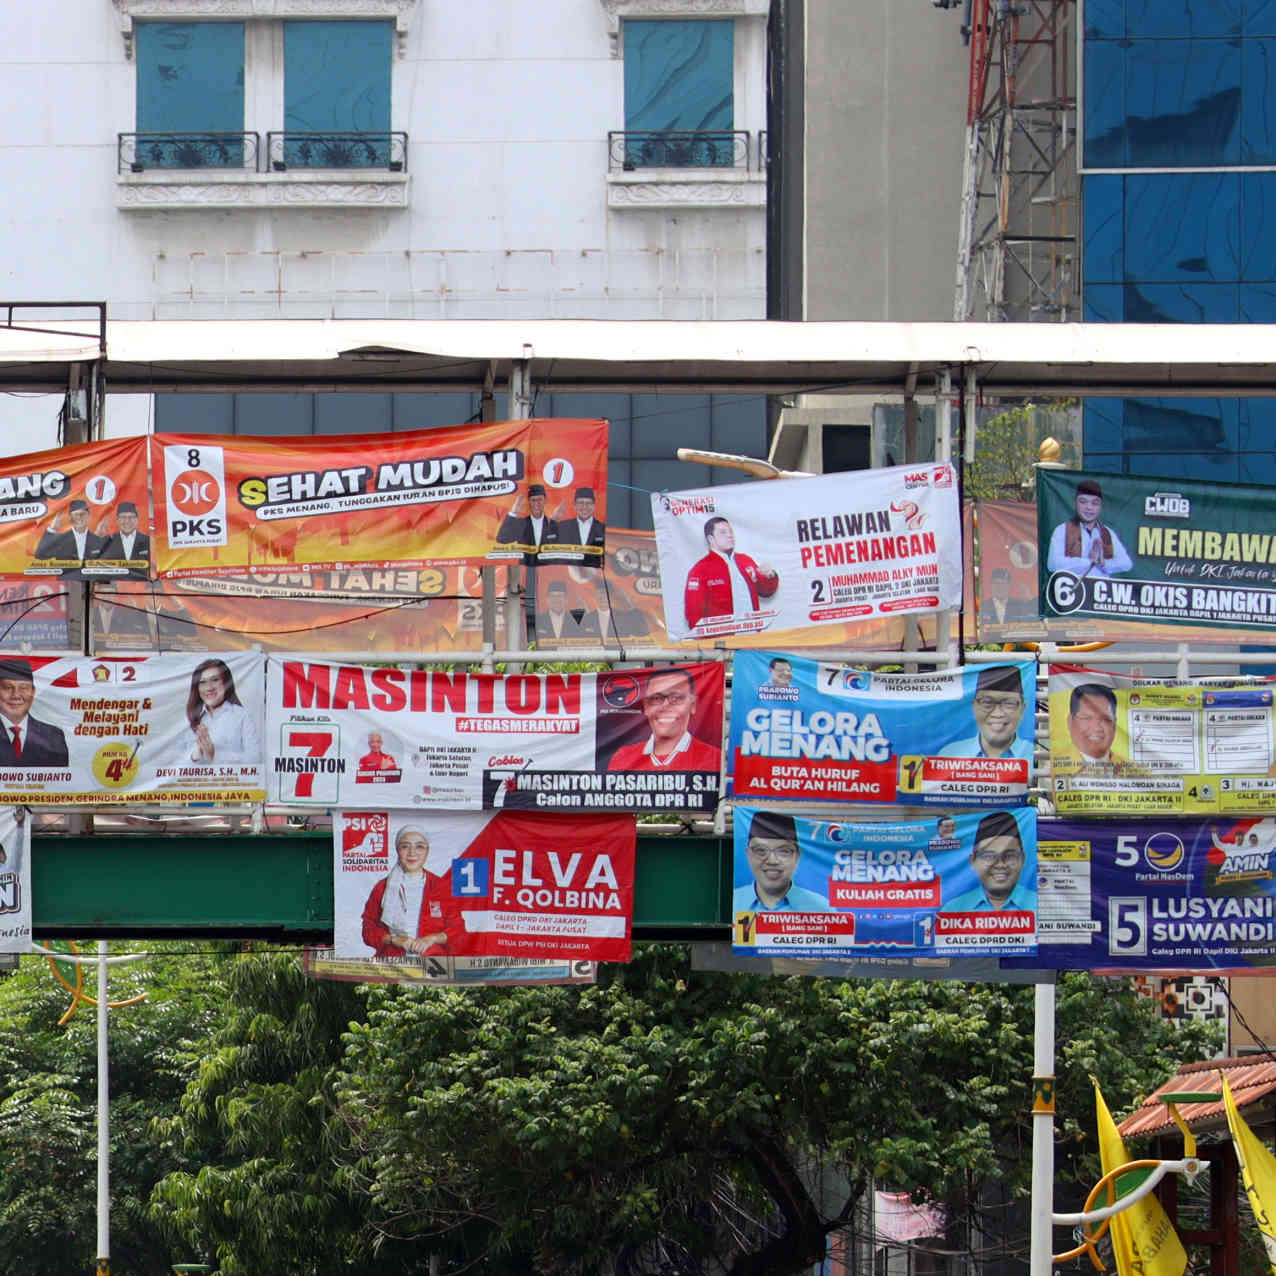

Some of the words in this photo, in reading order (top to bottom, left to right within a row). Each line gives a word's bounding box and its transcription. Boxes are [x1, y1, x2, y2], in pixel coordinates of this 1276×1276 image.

[188, 448, 200, 468] 8
[239, 469, 369, 506] SEHAT
[376, 451, 519, 490] MUDAH
[171, 518, 222, 537] PKS
[796, 510, 891, 543] RELAWAN
[800, 532, 938, 569] PEMENANGAN
[811, 580, 825, 604] 2
[1054, 576, 1076, 607] 6
[1093, 581, 1136, 606] C.W.
[1140, 585, 1188, 609] OKIS
[122, 667, 137, 682] 2
[282, 661, 582, 715] MASINTON
[70, 698, 140, 712] Mendengar
[83, 711, 139, 724] Melayani
[457, 718, 579, 733] #TEGASMERAKYAT
[746, 708, 884, 738] GELORA
[74, 725, 119, 738] dengan
[741, 730, 891, 762] MENANG
[274, 757, 346, 773] MASINTON
[771, 766, 809, 779] BUTA
[811, 767, 860, 780] HURUF
[929, 759, 1022, 772] TRIWISAKSANA
[26, 772, 72, 782] SUBIANTO
[517, 774, 602, 791] MASINTON
[606, 775, 691, 794] PASARIBU,
[749, 778, 770, 789] AL
[827, 780, 881, 793] HILANG
[536, 792, 582, 807] Calon
[585, 792, 651, 807] ANGGOTA
[653, 793, 685, 807] DPR
[1114, 836, 1140, 867] 5
[461, 862, 481, 894] 1
[493, 849, 619, 890] ELVA
[516, 888, 622, 910] QOLBINA
[836, 889, 885, 900] KULIAH
[887, 889, 934, 900] GRATIS
[1152, 897, 1273, 918] LUSYANI
[939, 917, 972, 929] DIKA
[974, 917, 1031, 930] RIDWAN
[1117, 903, 1141, 949] 5
[1152, 922, 1273, 942] SUWANDI
